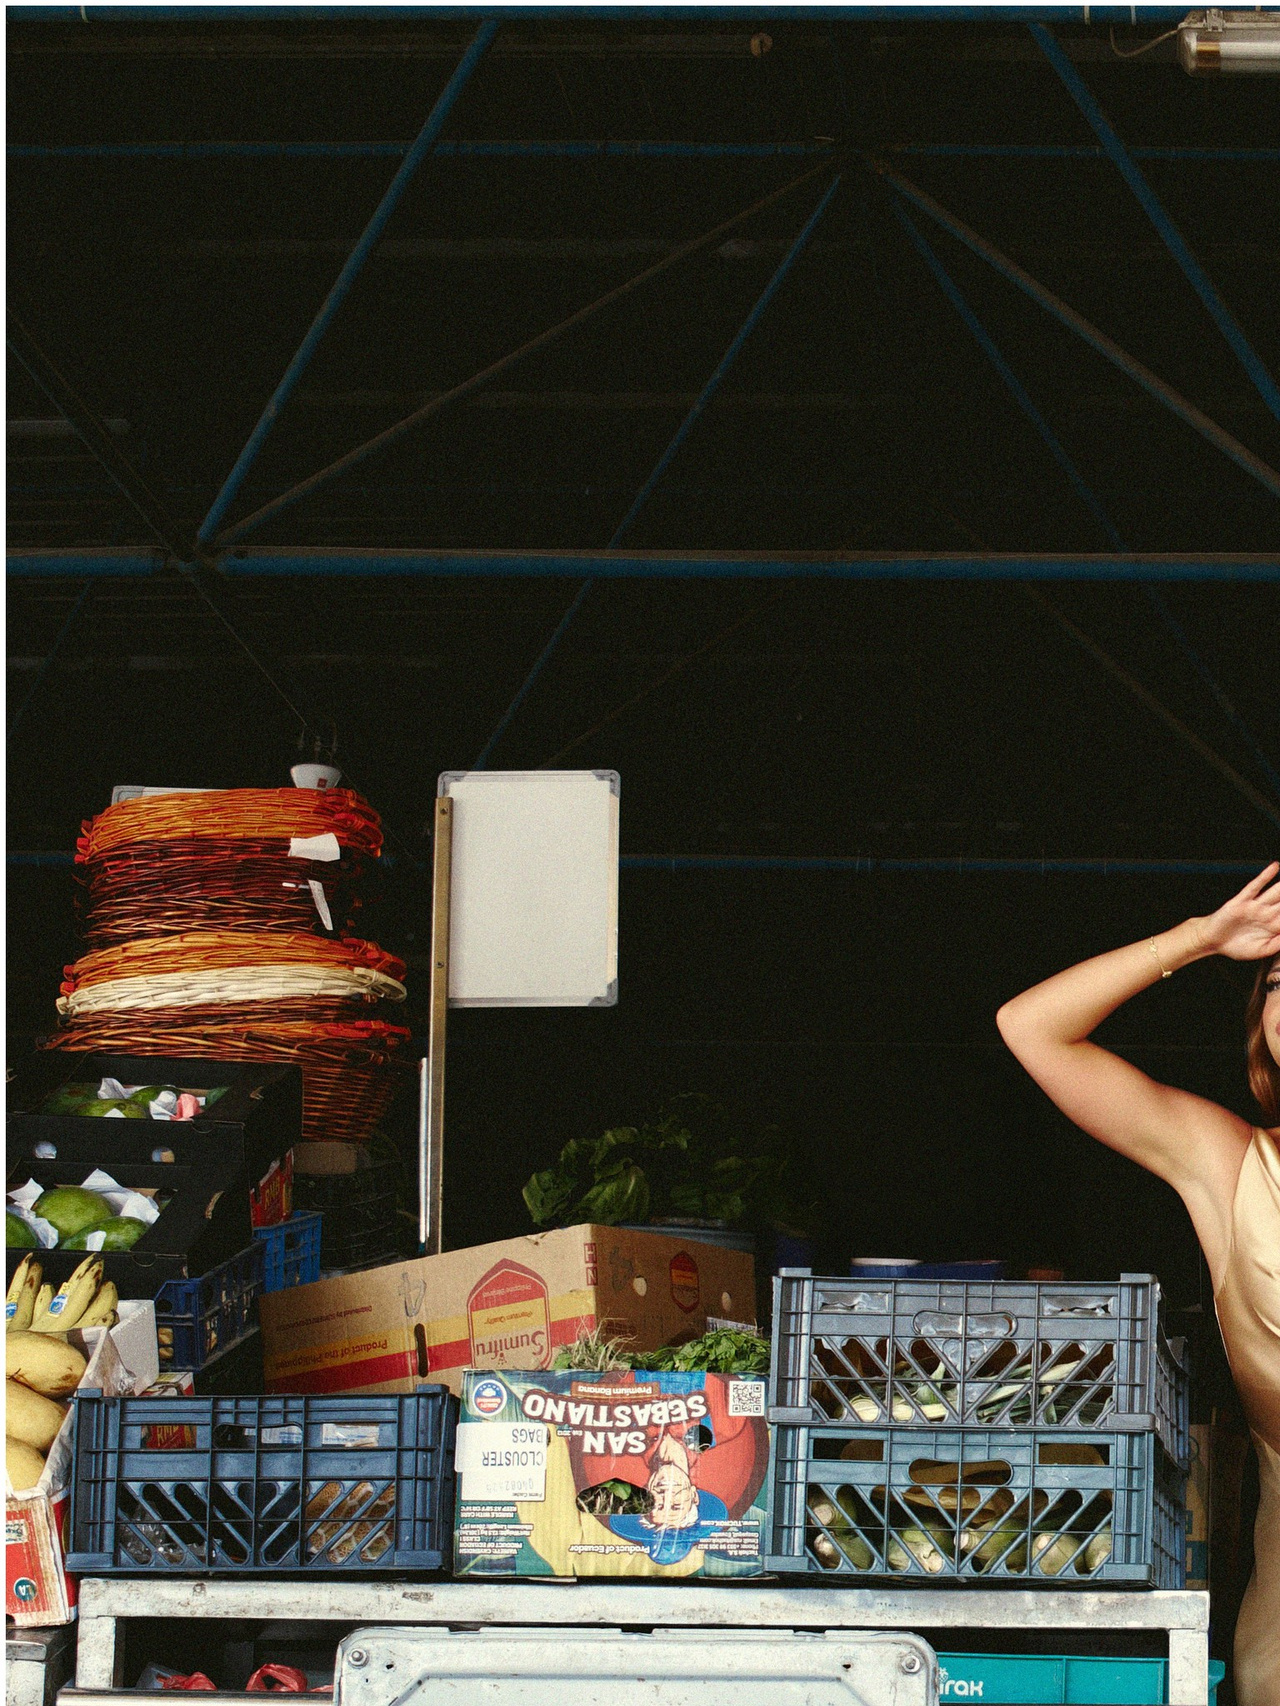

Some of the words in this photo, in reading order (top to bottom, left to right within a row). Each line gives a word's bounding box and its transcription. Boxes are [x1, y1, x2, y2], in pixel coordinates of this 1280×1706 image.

[352, 1340, 387, 1354] Product
[476, 1331, 545, 1360] Sumifru
[340, 1347, 350, 1358] of
[578, 1385, 612, 1396] Banana
[612, 1386, 652, 1396] Premium
[524, 1395, 707, 1427] SEBASTIANO
[512, 1428, 543, 1443] BAGS
[582, 1431, 647, 1453] SAN
[482, 1451, 543, 1466] CLOUSTER
[569, 1544, 605, 1553] Ecuador
[606, 1544, 616, 1553] of
[617, 1544, 650, 1554] Product
